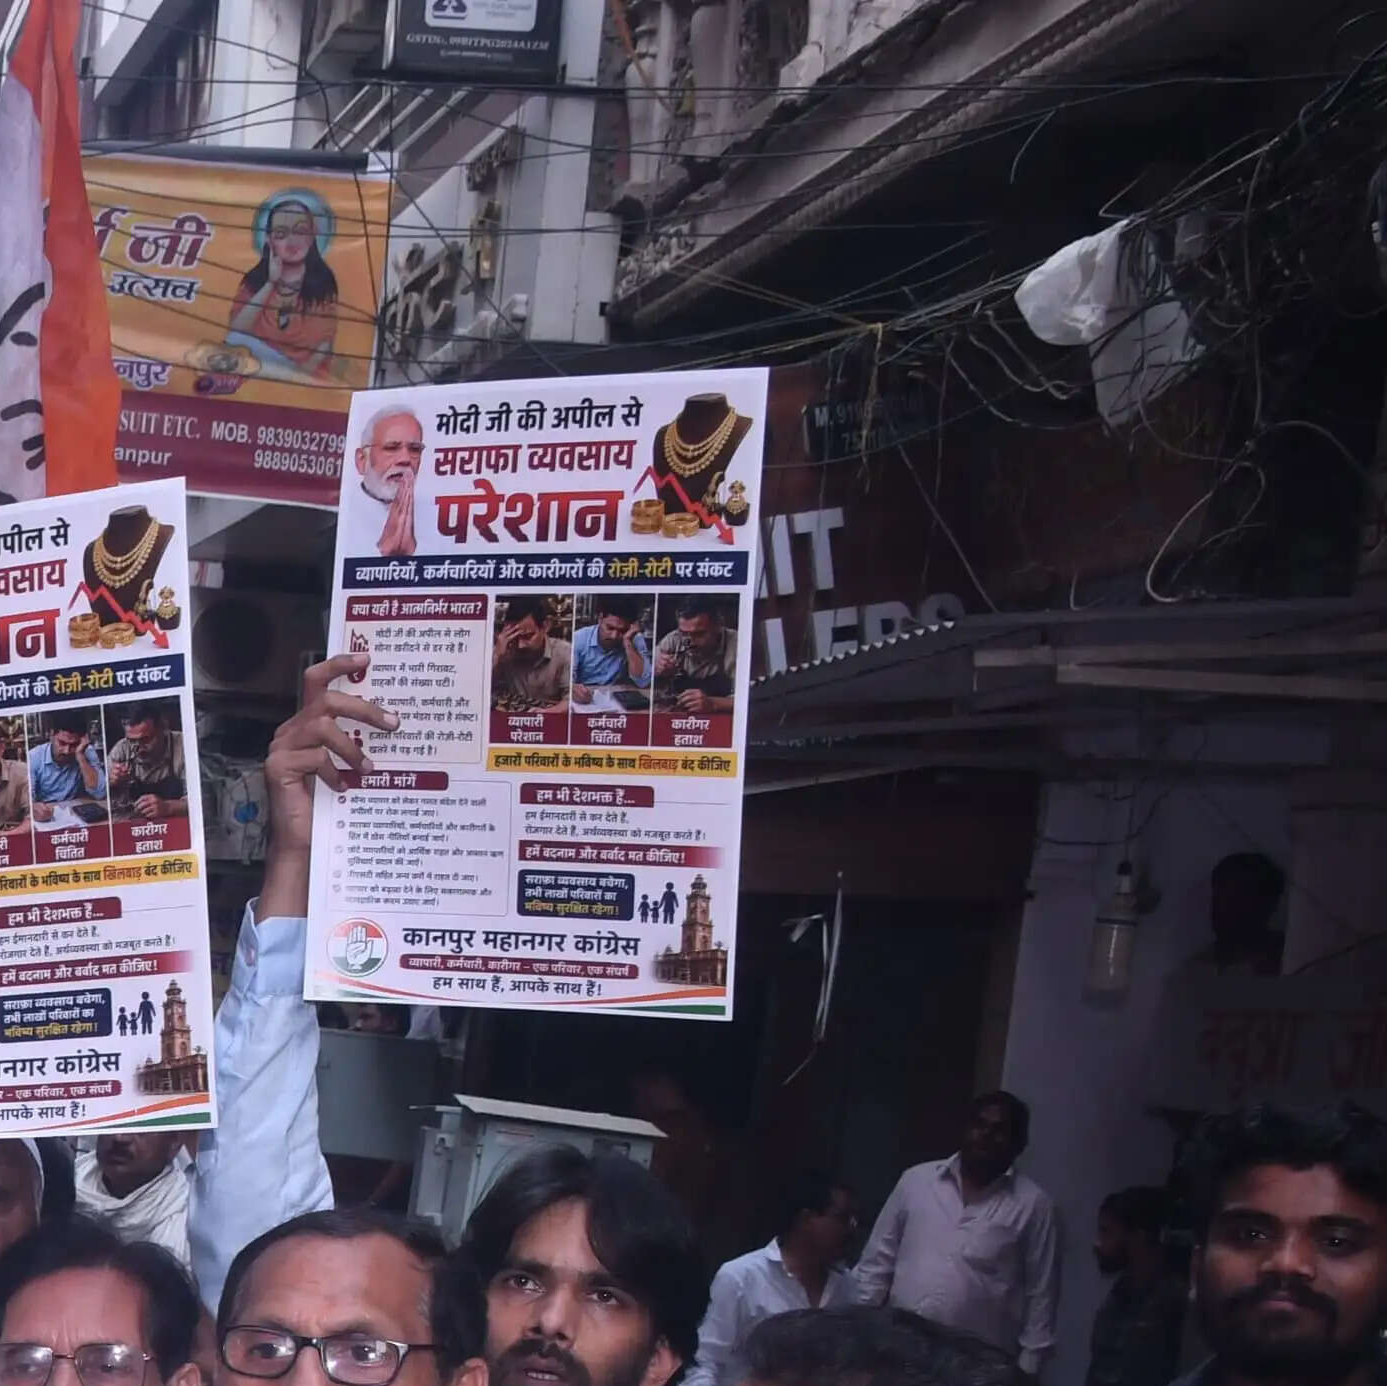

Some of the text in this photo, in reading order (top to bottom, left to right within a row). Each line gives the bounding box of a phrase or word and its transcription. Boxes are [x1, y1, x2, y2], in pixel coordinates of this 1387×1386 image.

[127, 214, 211, 269] जी
[113, 357, 172, 391] नपुर
[435, 395, 644, 436] मोदी जी की अपील से
[211, 419, 252, 446] MOB.
[114, 446, 172, 468] anpur
[433, 439, 638, 477] सराफा व्यवसाय
[434, 478, 625, 544] परेशान
[48, 516, 71, 548] से
[402, 927, 641, 956] कानपुर महानगर कांग्रेस
[54, 1048, 122, 1075] कांग्रेस
